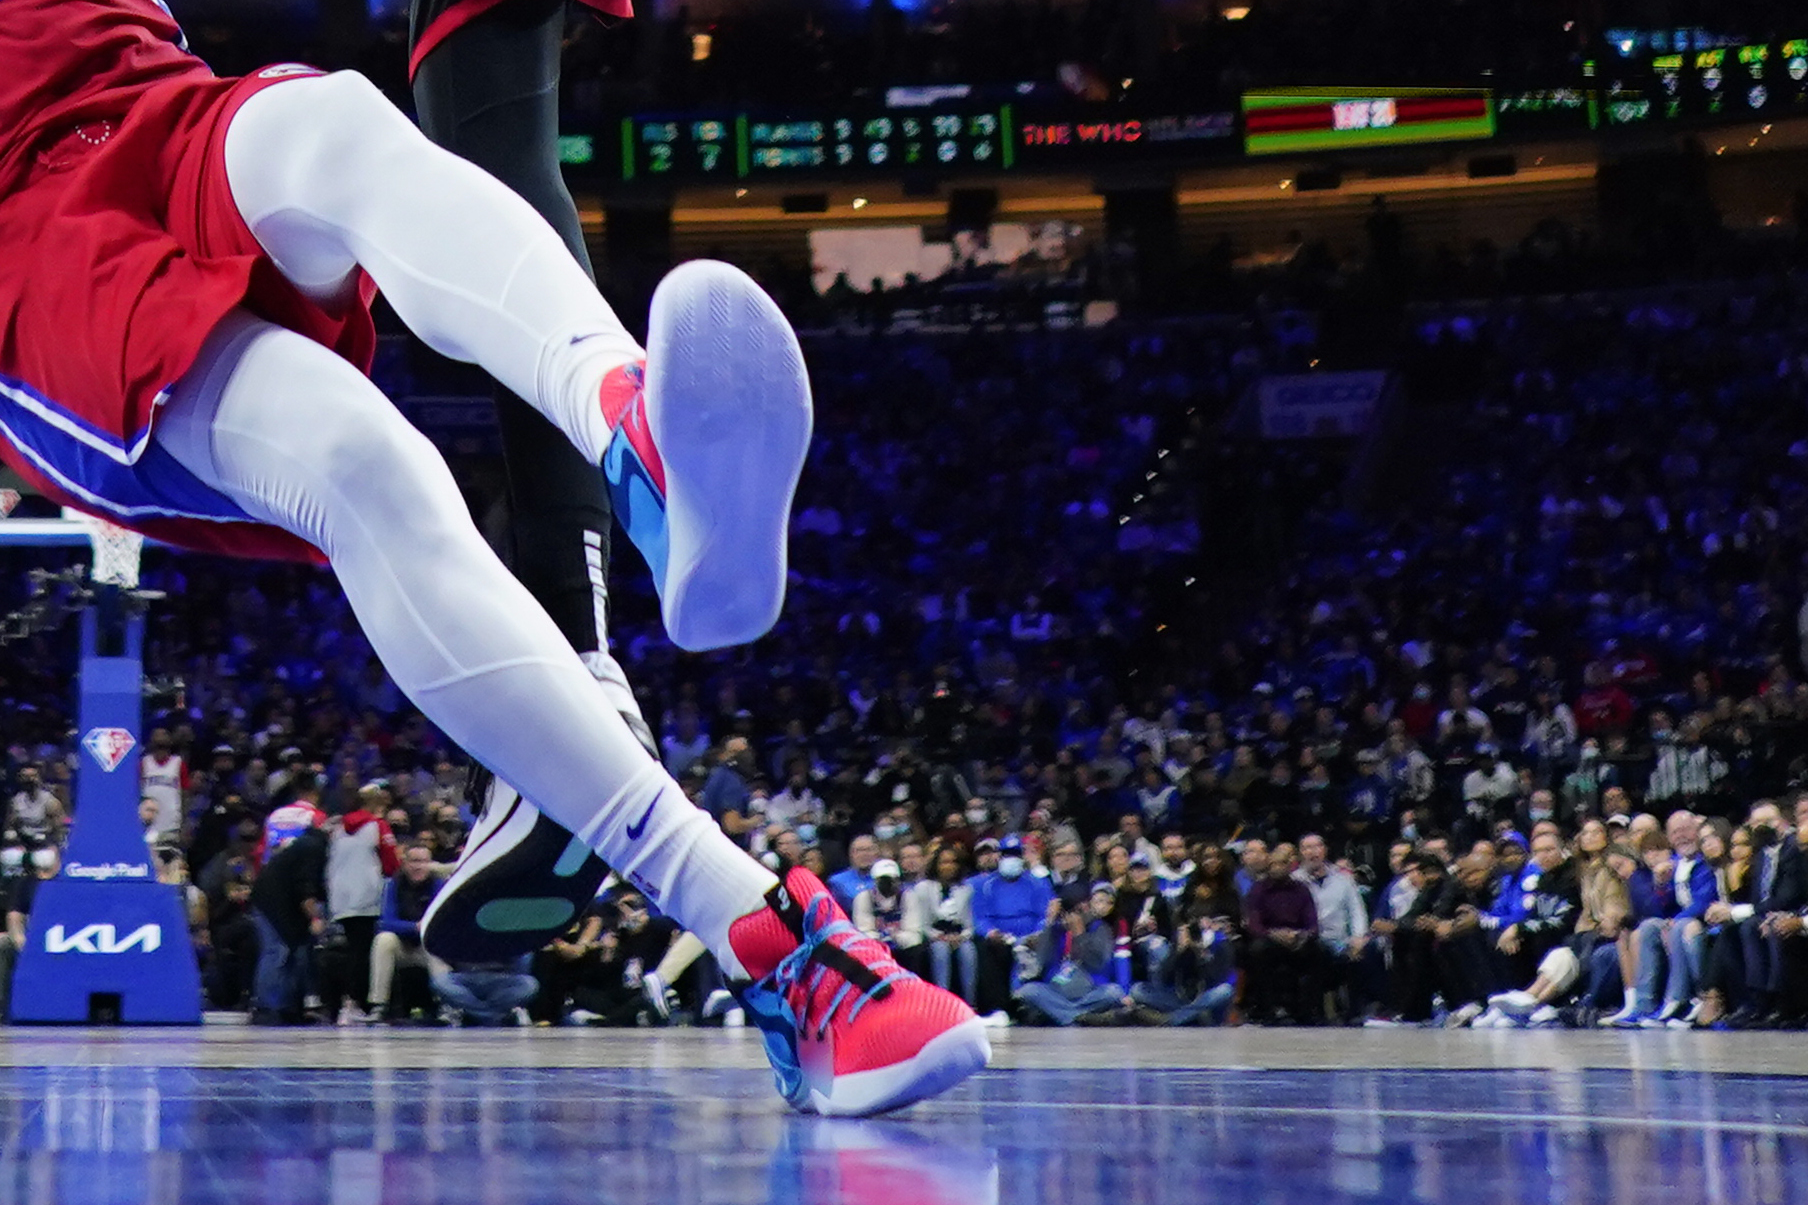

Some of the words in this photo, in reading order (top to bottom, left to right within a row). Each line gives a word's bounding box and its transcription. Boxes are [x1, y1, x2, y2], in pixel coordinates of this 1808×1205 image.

[1023, 123, 1071, 145] THE
[1076, 119, 1143, 143] WHO
[44, 922, 162, 954] KIA
